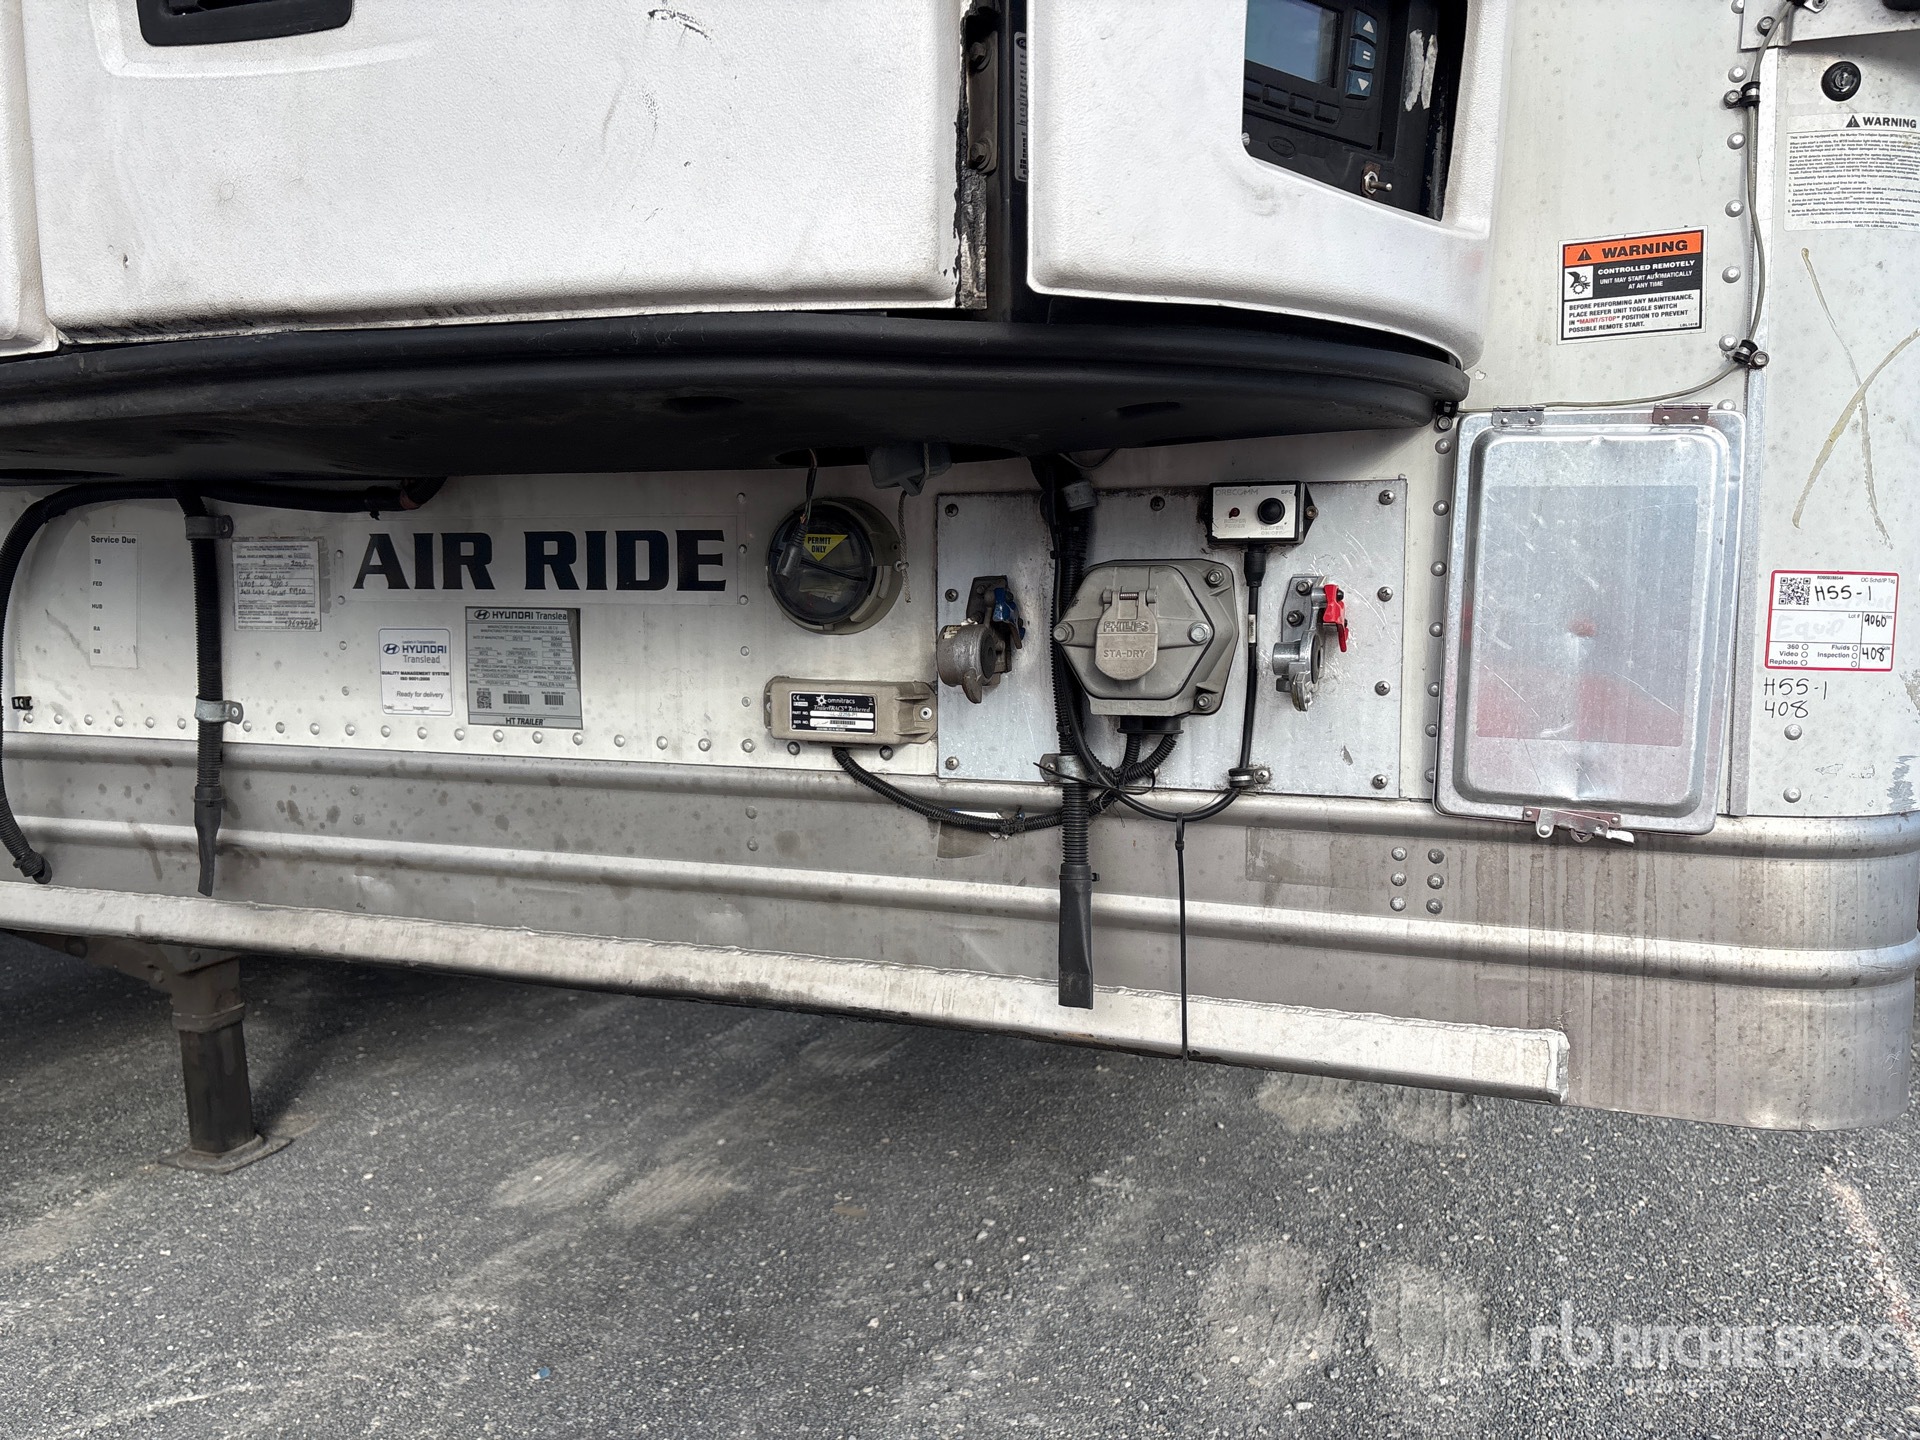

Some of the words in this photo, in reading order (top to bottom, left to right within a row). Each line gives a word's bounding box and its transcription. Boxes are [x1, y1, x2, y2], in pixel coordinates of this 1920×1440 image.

[1863, 116, 1916, 128] WARNING
[1602, 240, 1688, 258] WARNING
[1598, 264, 1650, 275] CONTROLLED
[1652, 260, 1695, 270] REMOTELY
[1647, 270, 1692, 280] AUTOMATICALLY
[1594, 299, 1632, 308] PERFORMING
[1648, 294, 1694, 303] MAINTENANCE,
[1589, 308, 1612, 316] REEFER
[1622, 313, 1650, 321] POSITION
[1661, 309, 1688, 317] PREVENT
[1569, 325, 1597, 333] POSSIBLE
[1599, 323, 1623, 331] REMOTE
[1625, 320, 1645, 328] START.
[808, 536, 831, 545] PERMIT
[352, 532, 496, 590] AIR
[523, 530, 727, 592] RIDE
[492, 611, 533, 619] HYUNDAI
[536, 612, 566, 620] Translea
[1864, 614, 1887, 627] 9060
[1103, 621, 1149, 632] PHILLIPS
[402, 645, 446, 654] HYUNDAI
[1103, 649, 1146, 658] STA-DRY
[1862, 647, 1884, 662] 408
[403, 655, 440, 663] Translead
[1764, 700, 1809, 718] 408
